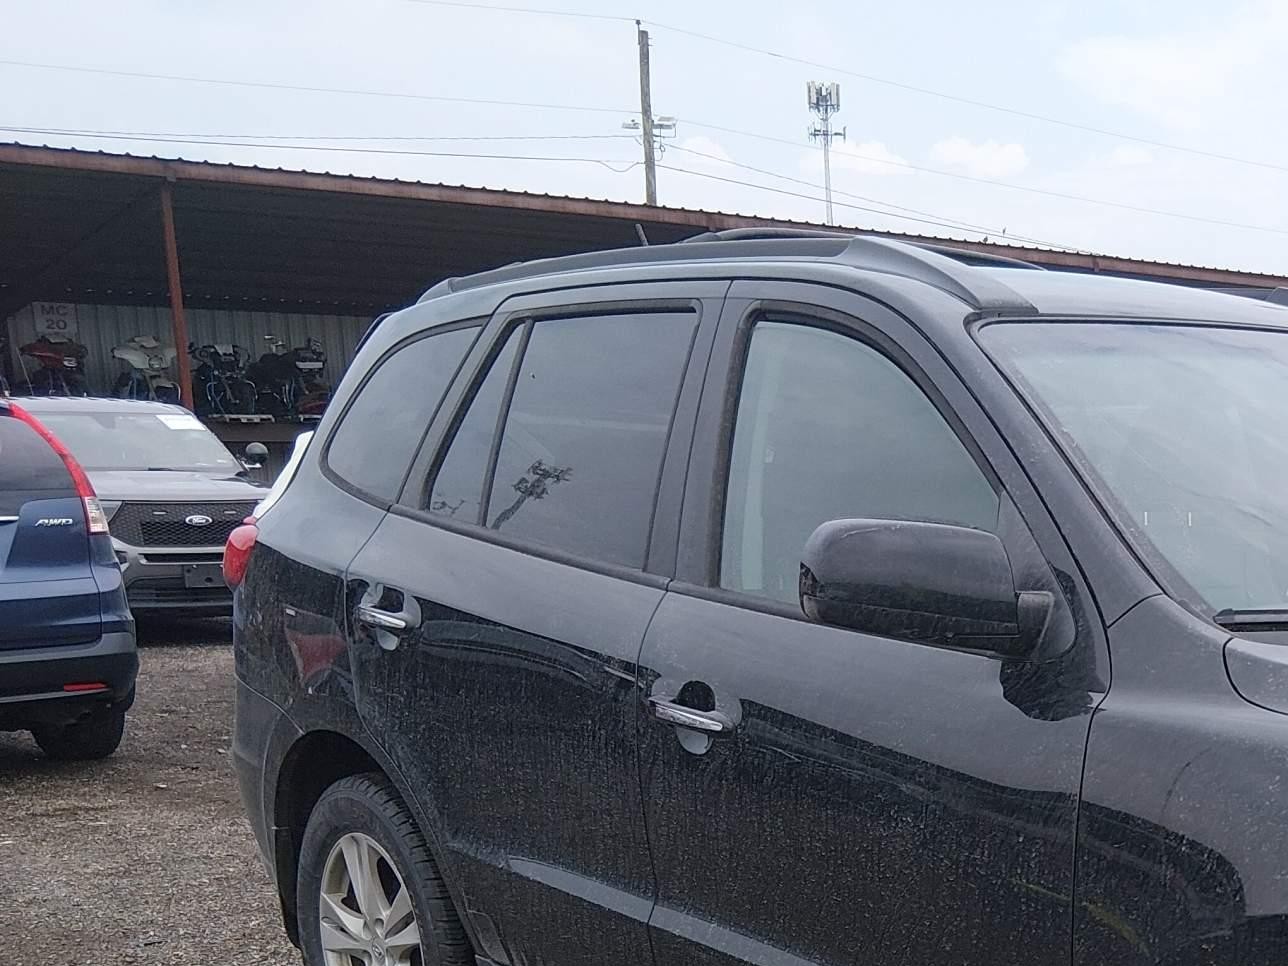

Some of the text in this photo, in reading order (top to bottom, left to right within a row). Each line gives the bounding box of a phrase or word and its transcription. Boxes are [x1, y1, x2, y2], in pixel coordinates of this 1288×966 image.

[41, 304, 69, 316] MC
[46, 319, 68, 330] 20
[35, 518, 73, 527] AWD
